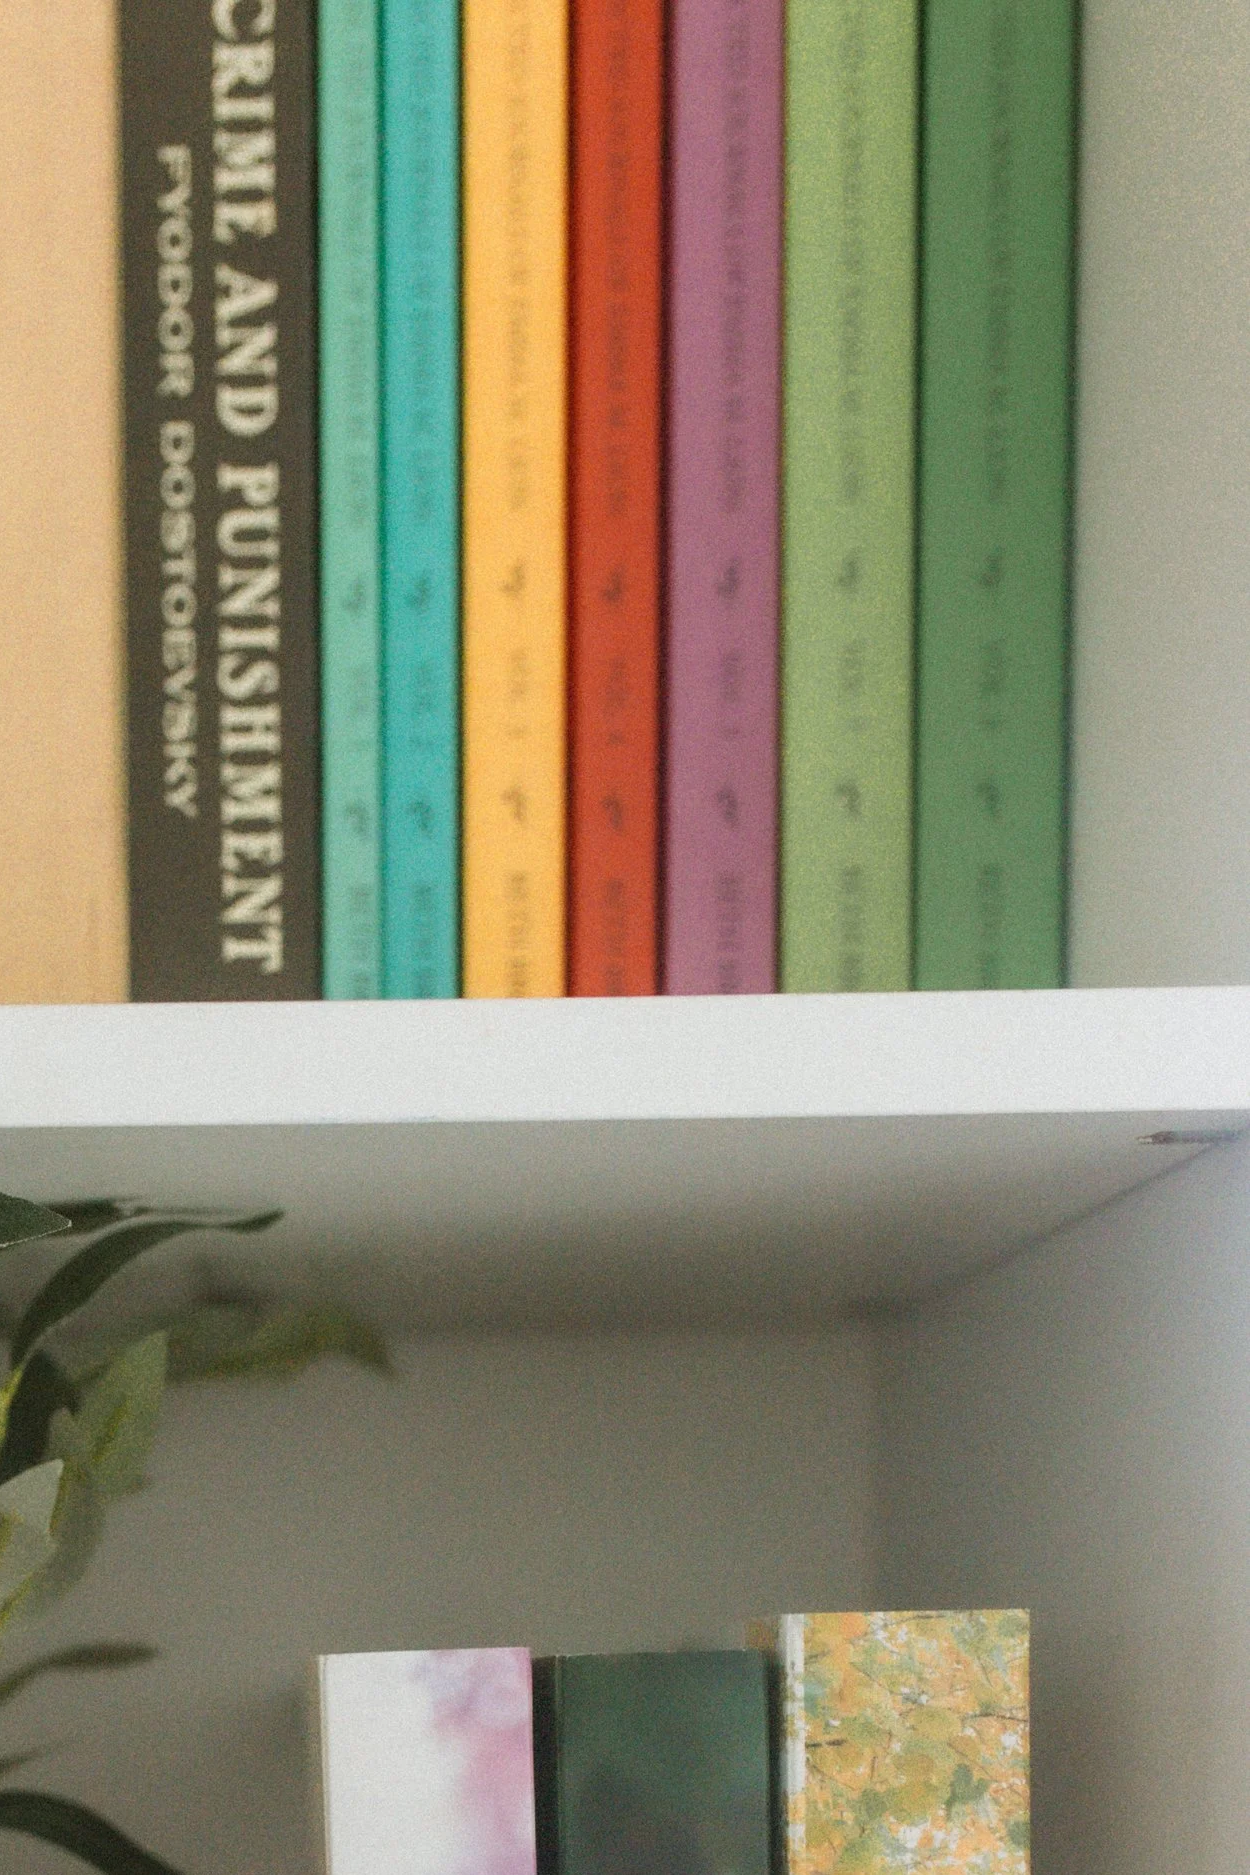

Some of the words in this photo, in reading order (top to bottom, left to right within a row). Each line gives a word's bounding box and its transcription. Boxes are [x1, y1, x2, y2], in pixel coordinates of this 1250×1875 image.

[211, 0, 277, 242] CRIME
[157, 144, 195, 399] FYODOR
[215, 267, 280, 437] AND
[159, 421, 200, 819] DOSTOEVSKY
[216, 464, 285, 973] PUNISHMENT
